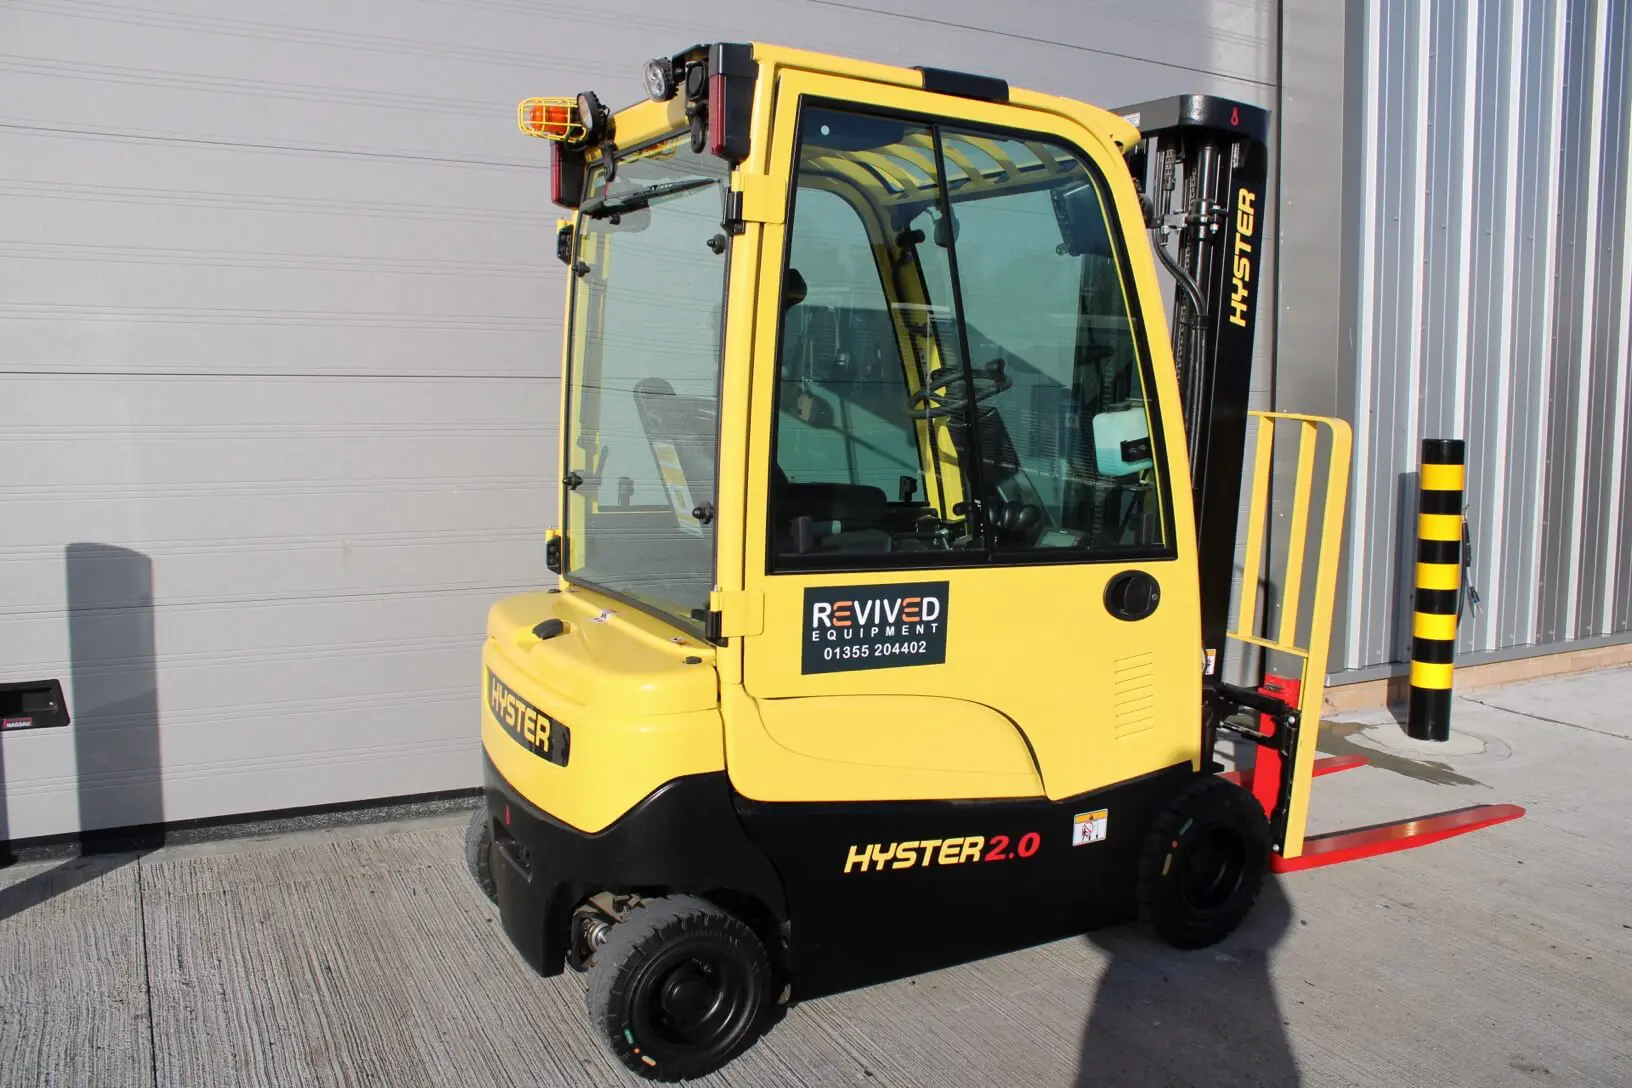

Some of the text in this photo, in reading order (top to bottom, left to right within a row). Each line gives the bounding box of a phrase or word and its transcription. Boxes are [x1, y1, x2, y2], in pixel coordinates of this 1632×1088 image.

[1229, 187, 1256, 328] HYSTER
[812, 596, 941, 628] REVIVED
[812, 623, 938, 642] EQUIPMENT
[824, 640, 927, 660] 01355 204402
[491, 677, 551, 753] HYSTER
[843, 832, 1041, 874] HYSTER 2.0
